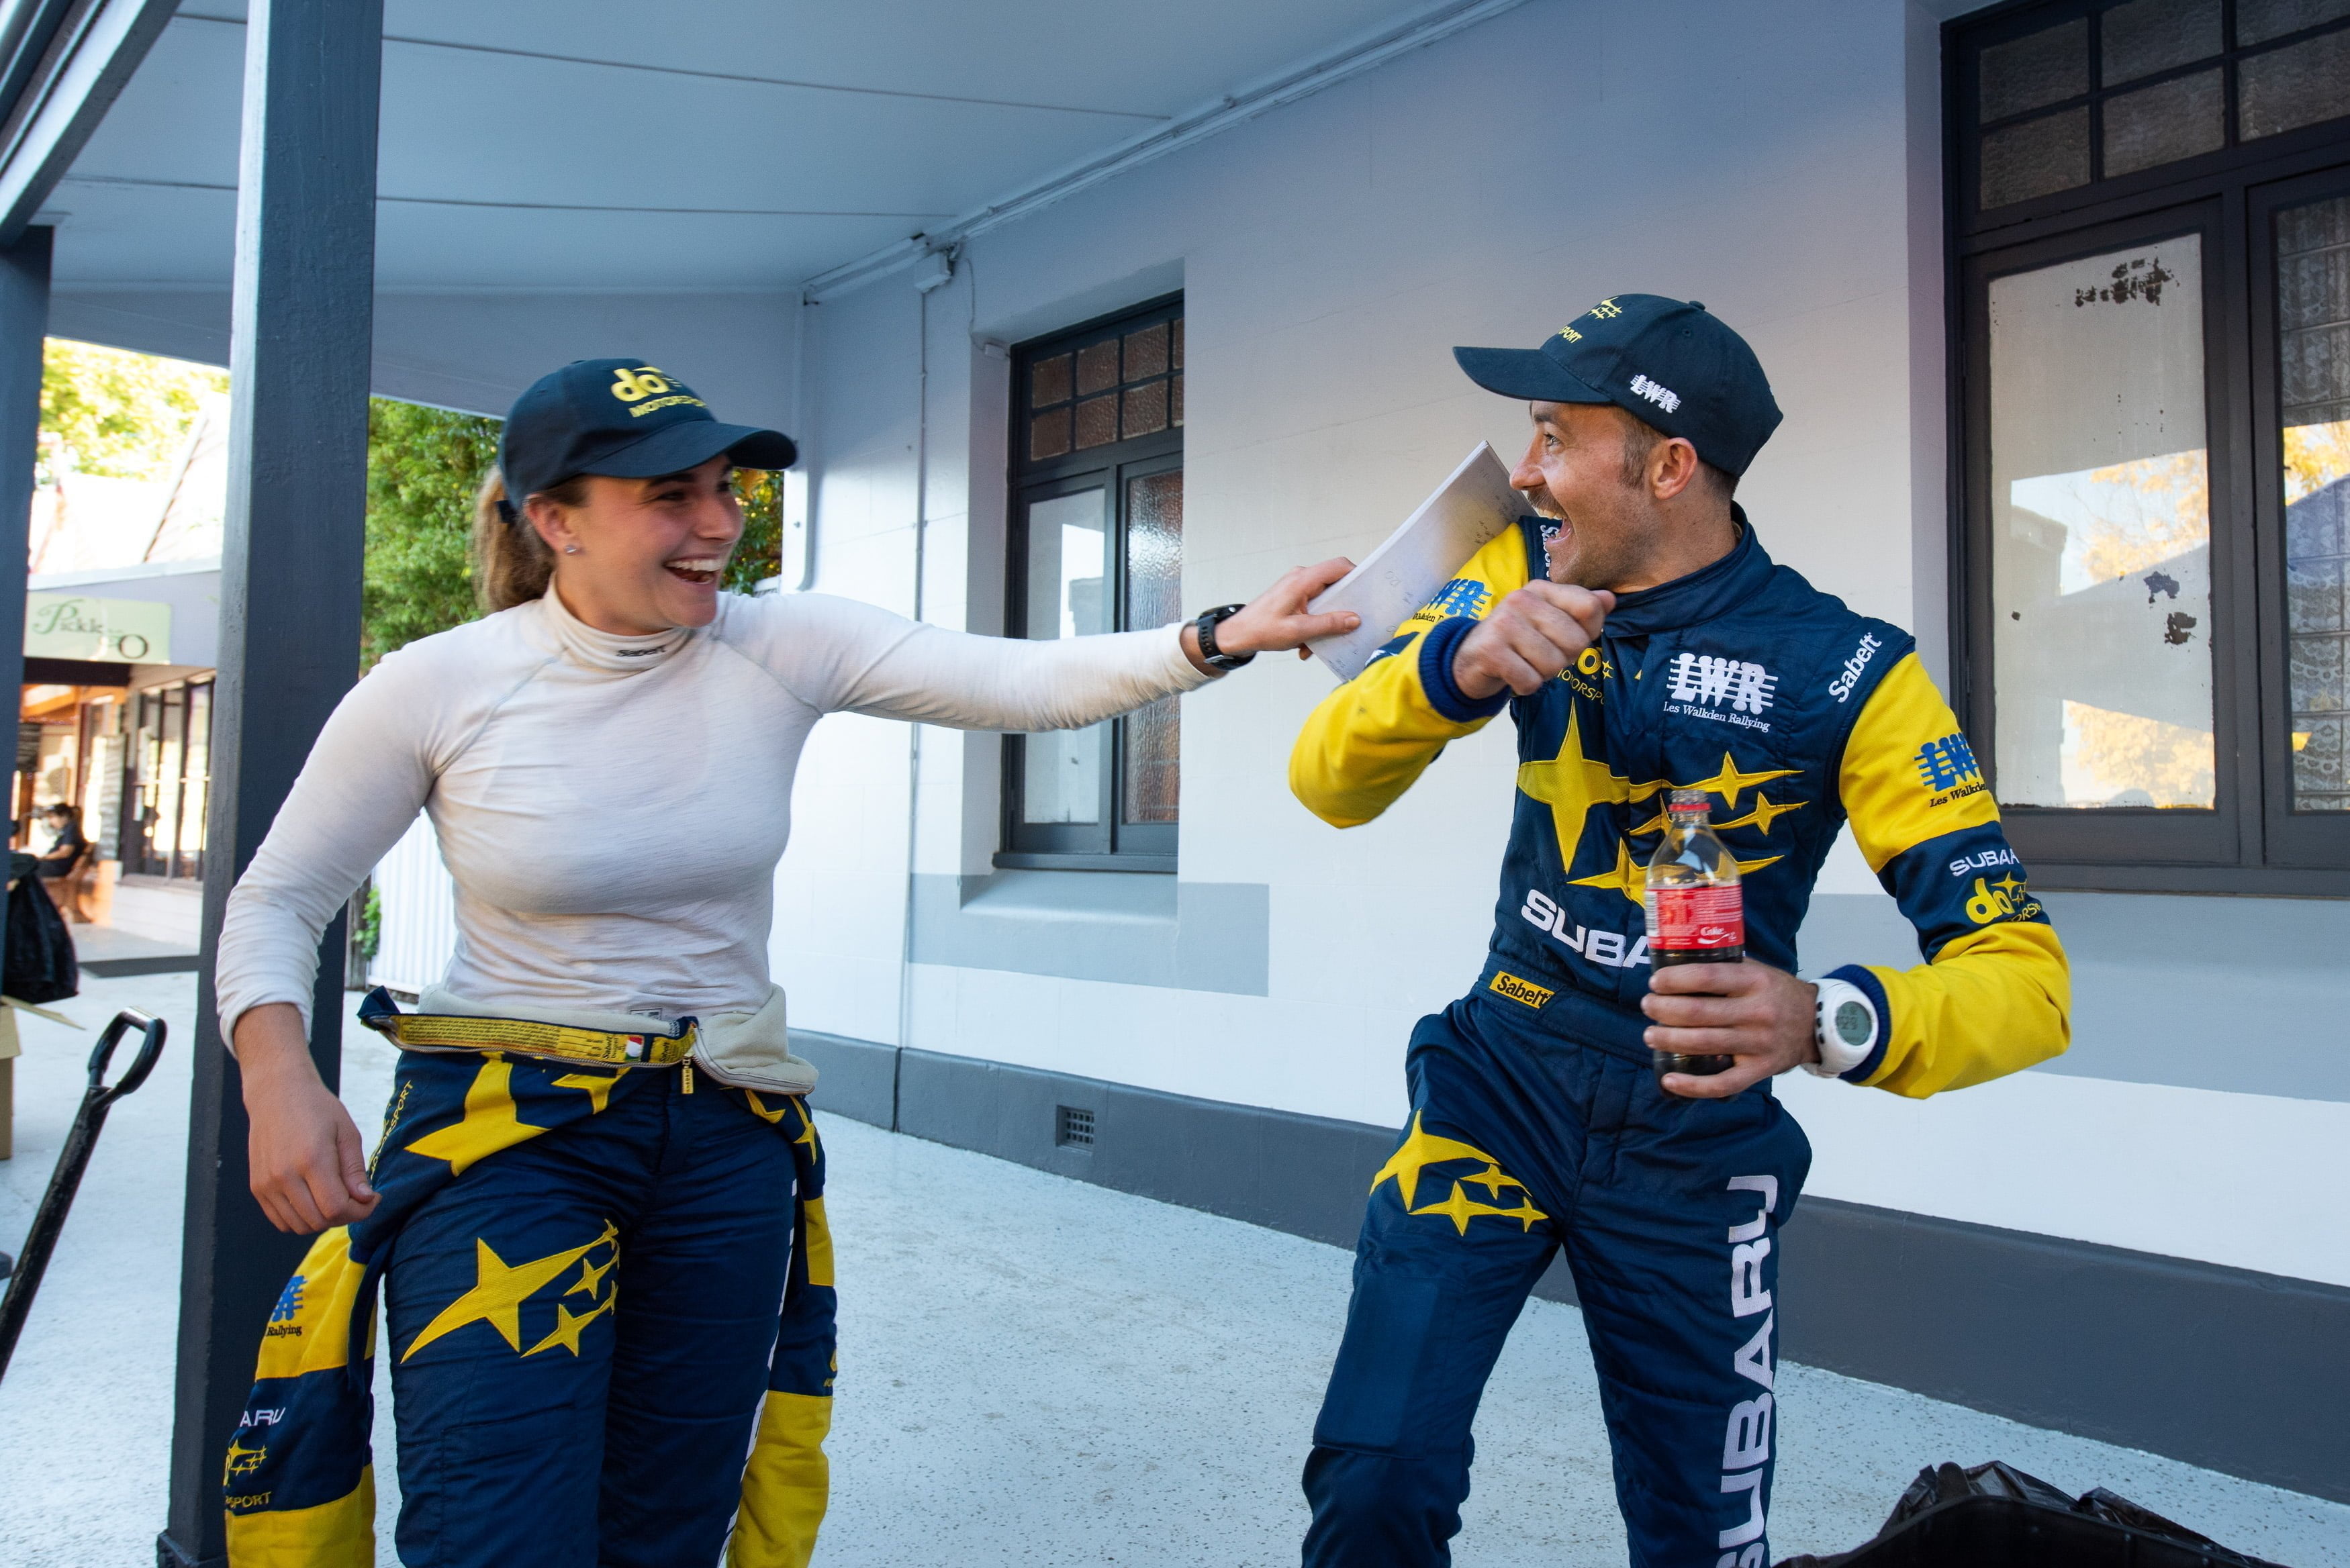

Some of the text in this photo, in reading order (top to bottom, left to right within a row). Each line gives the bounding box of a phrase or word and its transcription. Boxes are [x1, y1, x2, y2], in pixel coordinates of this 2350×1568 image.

[1630, 374, 1682, 413] LWR
[1666, 652, 1779, 715] LWR
[1828, 632, 1883, 703] Sabelt
[1662, 701, 1771, 734] Les Walkden Rallying
[1929, 796, 1948, 807] Les
[1496, 975, 1553, 1008] Sabelt
[267, 1324, 302, 1338] Rallying
